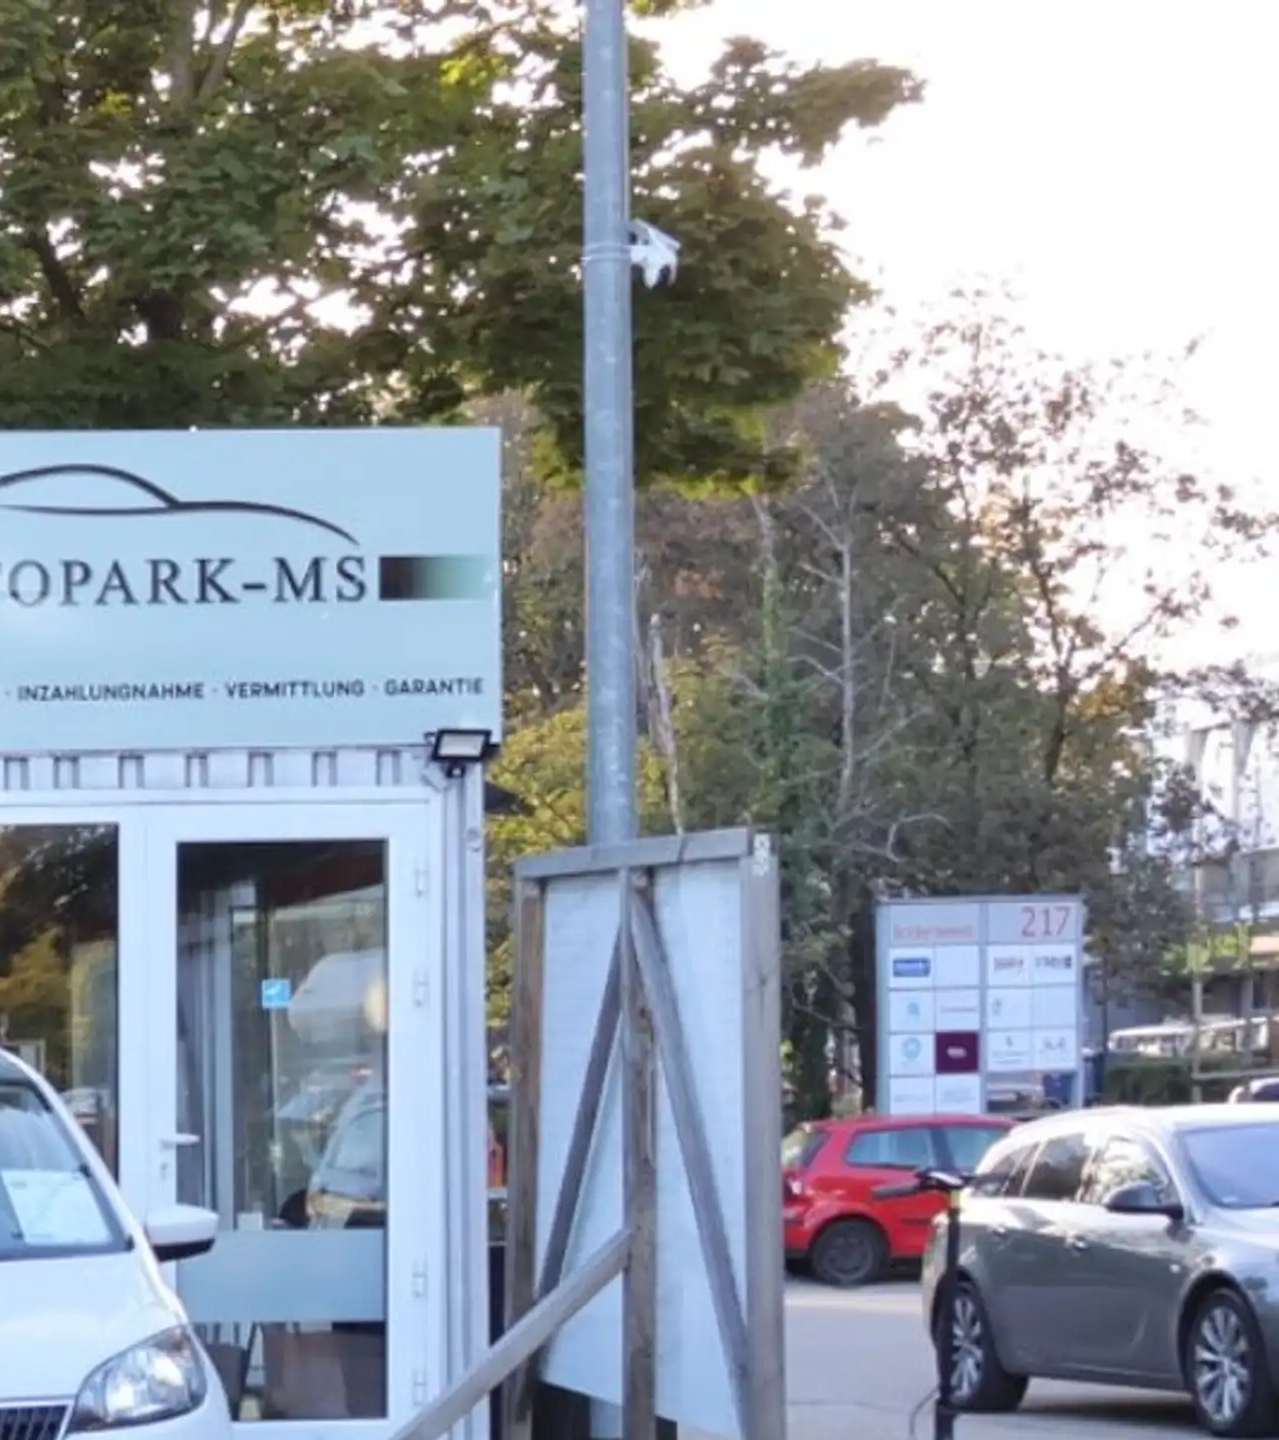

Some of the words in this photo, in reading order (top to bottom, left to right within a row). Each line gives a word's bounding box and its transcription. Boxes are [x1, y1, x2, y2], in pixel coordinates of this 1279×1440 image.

[17, 681, 205, 701] INZAHLUNGNAHME
[225, 680, 365, 699] VERMITTLUNG
[384, 677, 484, 697] GARANTIE
[1021, 905, 1071, 938] 217
